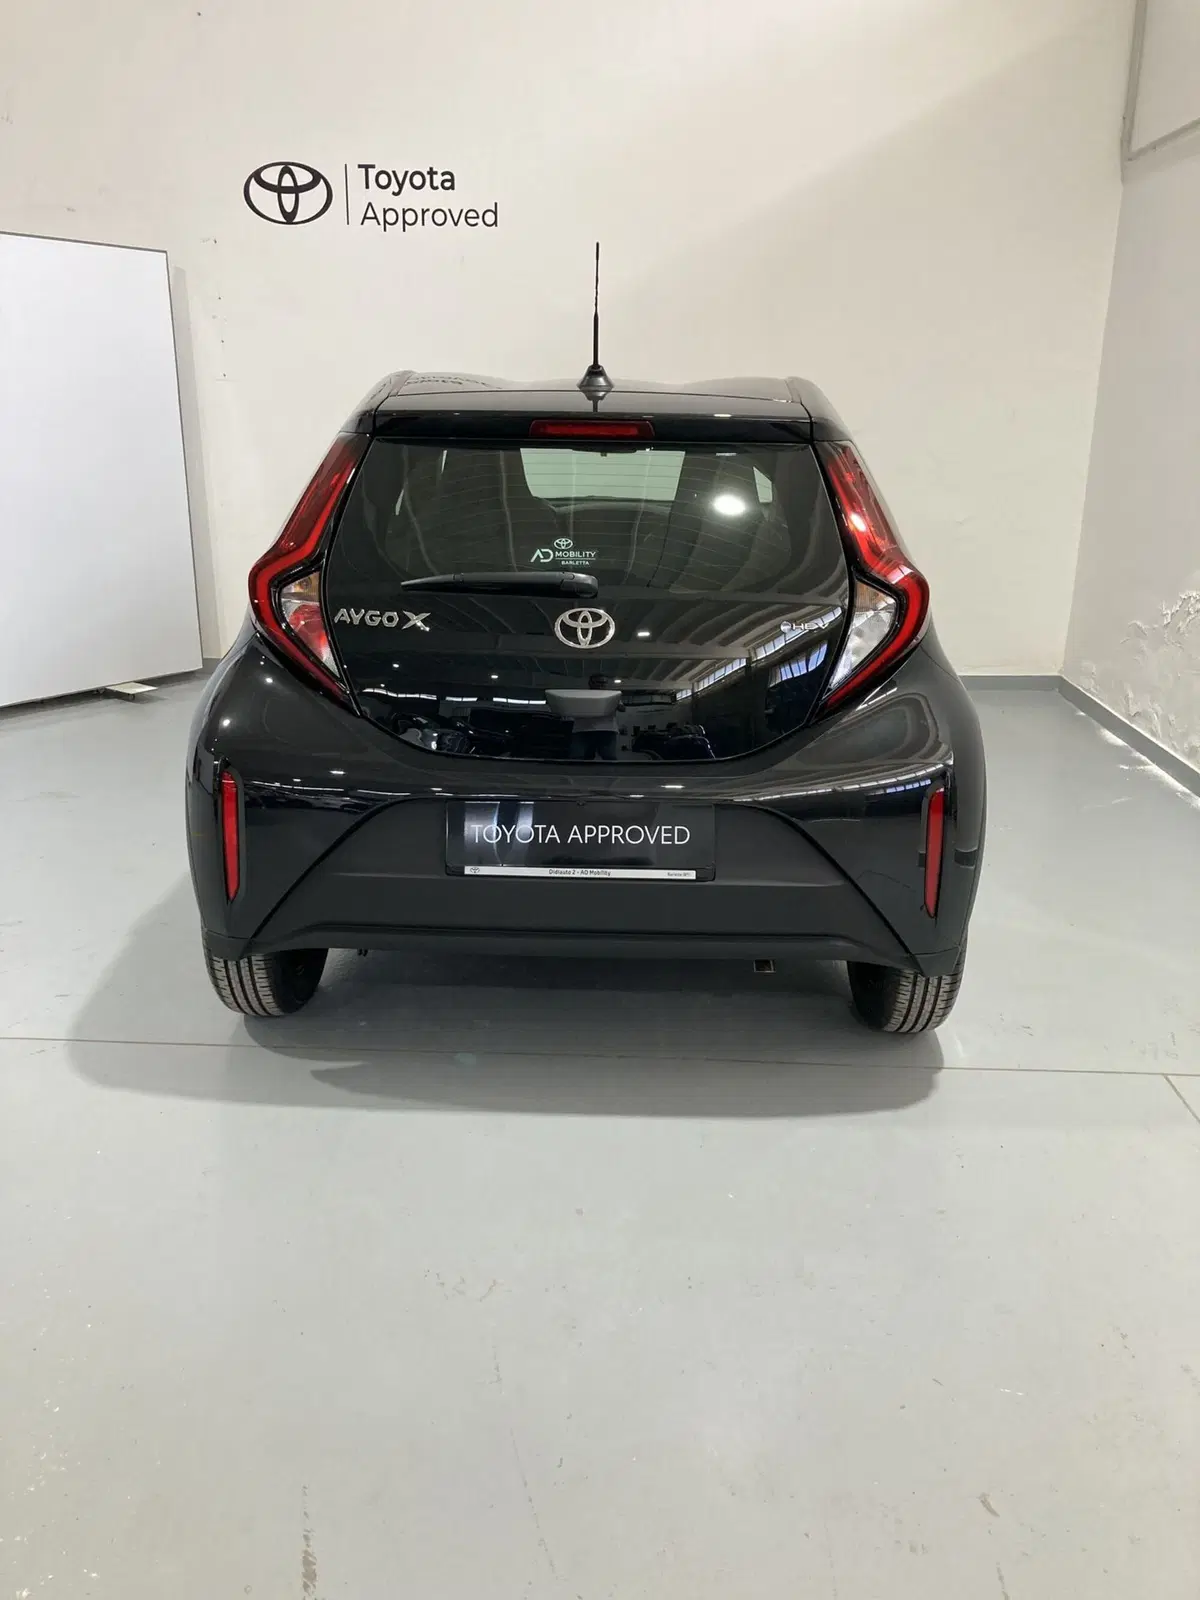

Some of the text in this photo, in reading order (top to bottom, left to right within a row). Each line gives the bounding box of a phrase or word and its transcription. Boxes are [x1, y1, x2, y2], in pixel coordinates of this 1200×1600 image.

[357, 163, 455, 197] Toyota
[360, 201, 498, 232] Approved
[555, 551, 596, 559] MOBILITY
[334, 608, 431, 632] AYGO X
[470, 824, 690, 845] TOYOTA APPROVED
